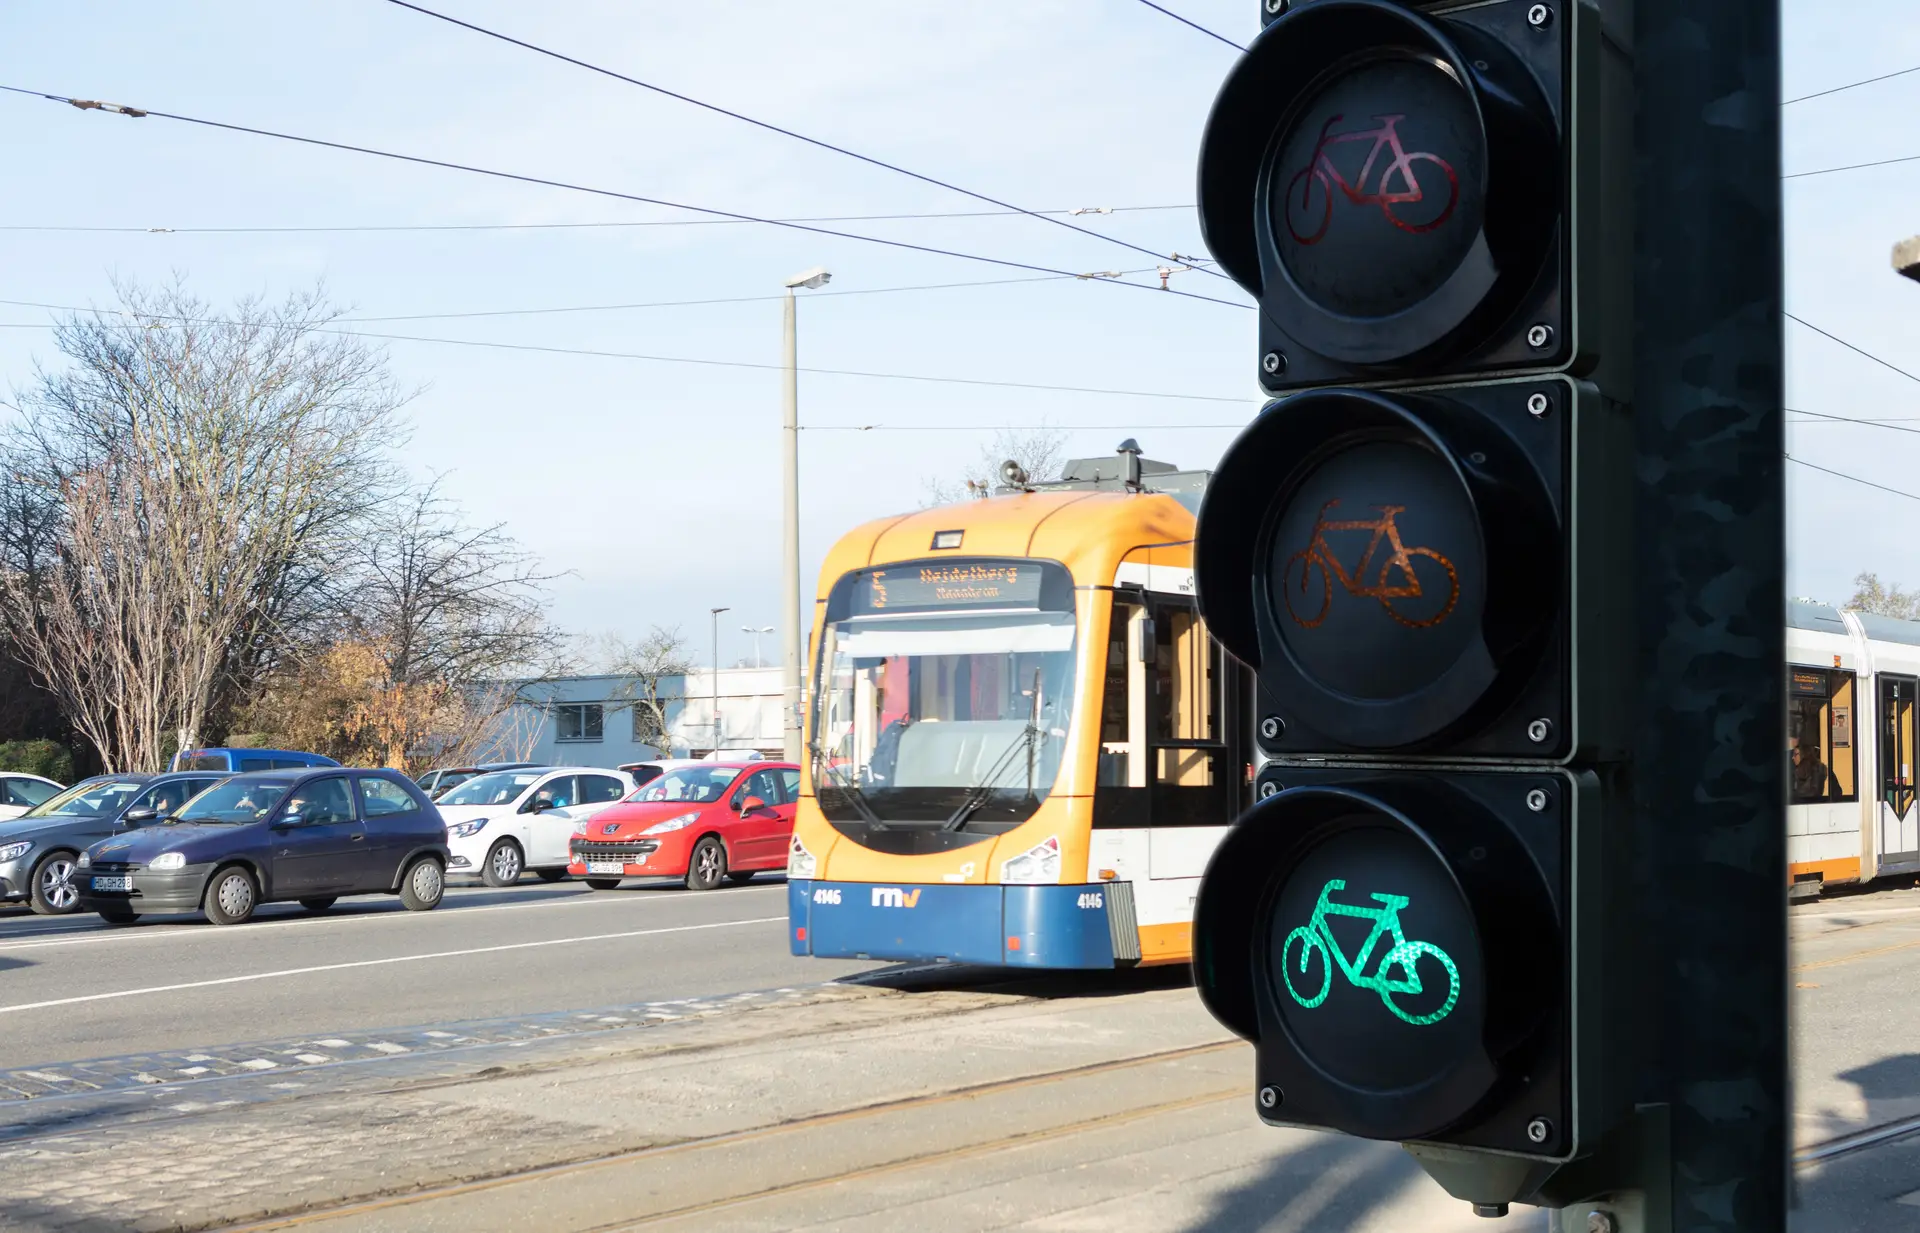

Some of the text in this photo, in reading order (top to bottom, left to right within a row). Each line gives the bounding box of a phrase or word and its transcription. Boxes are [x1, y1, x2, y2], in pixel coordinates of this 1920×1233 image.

[920, 567, 1018, 584] Heidelberg
[872, 571, 887, 608] 5
[814, 889, 842, 904] 4146
[1077, 893, 1103, 908] 4146
